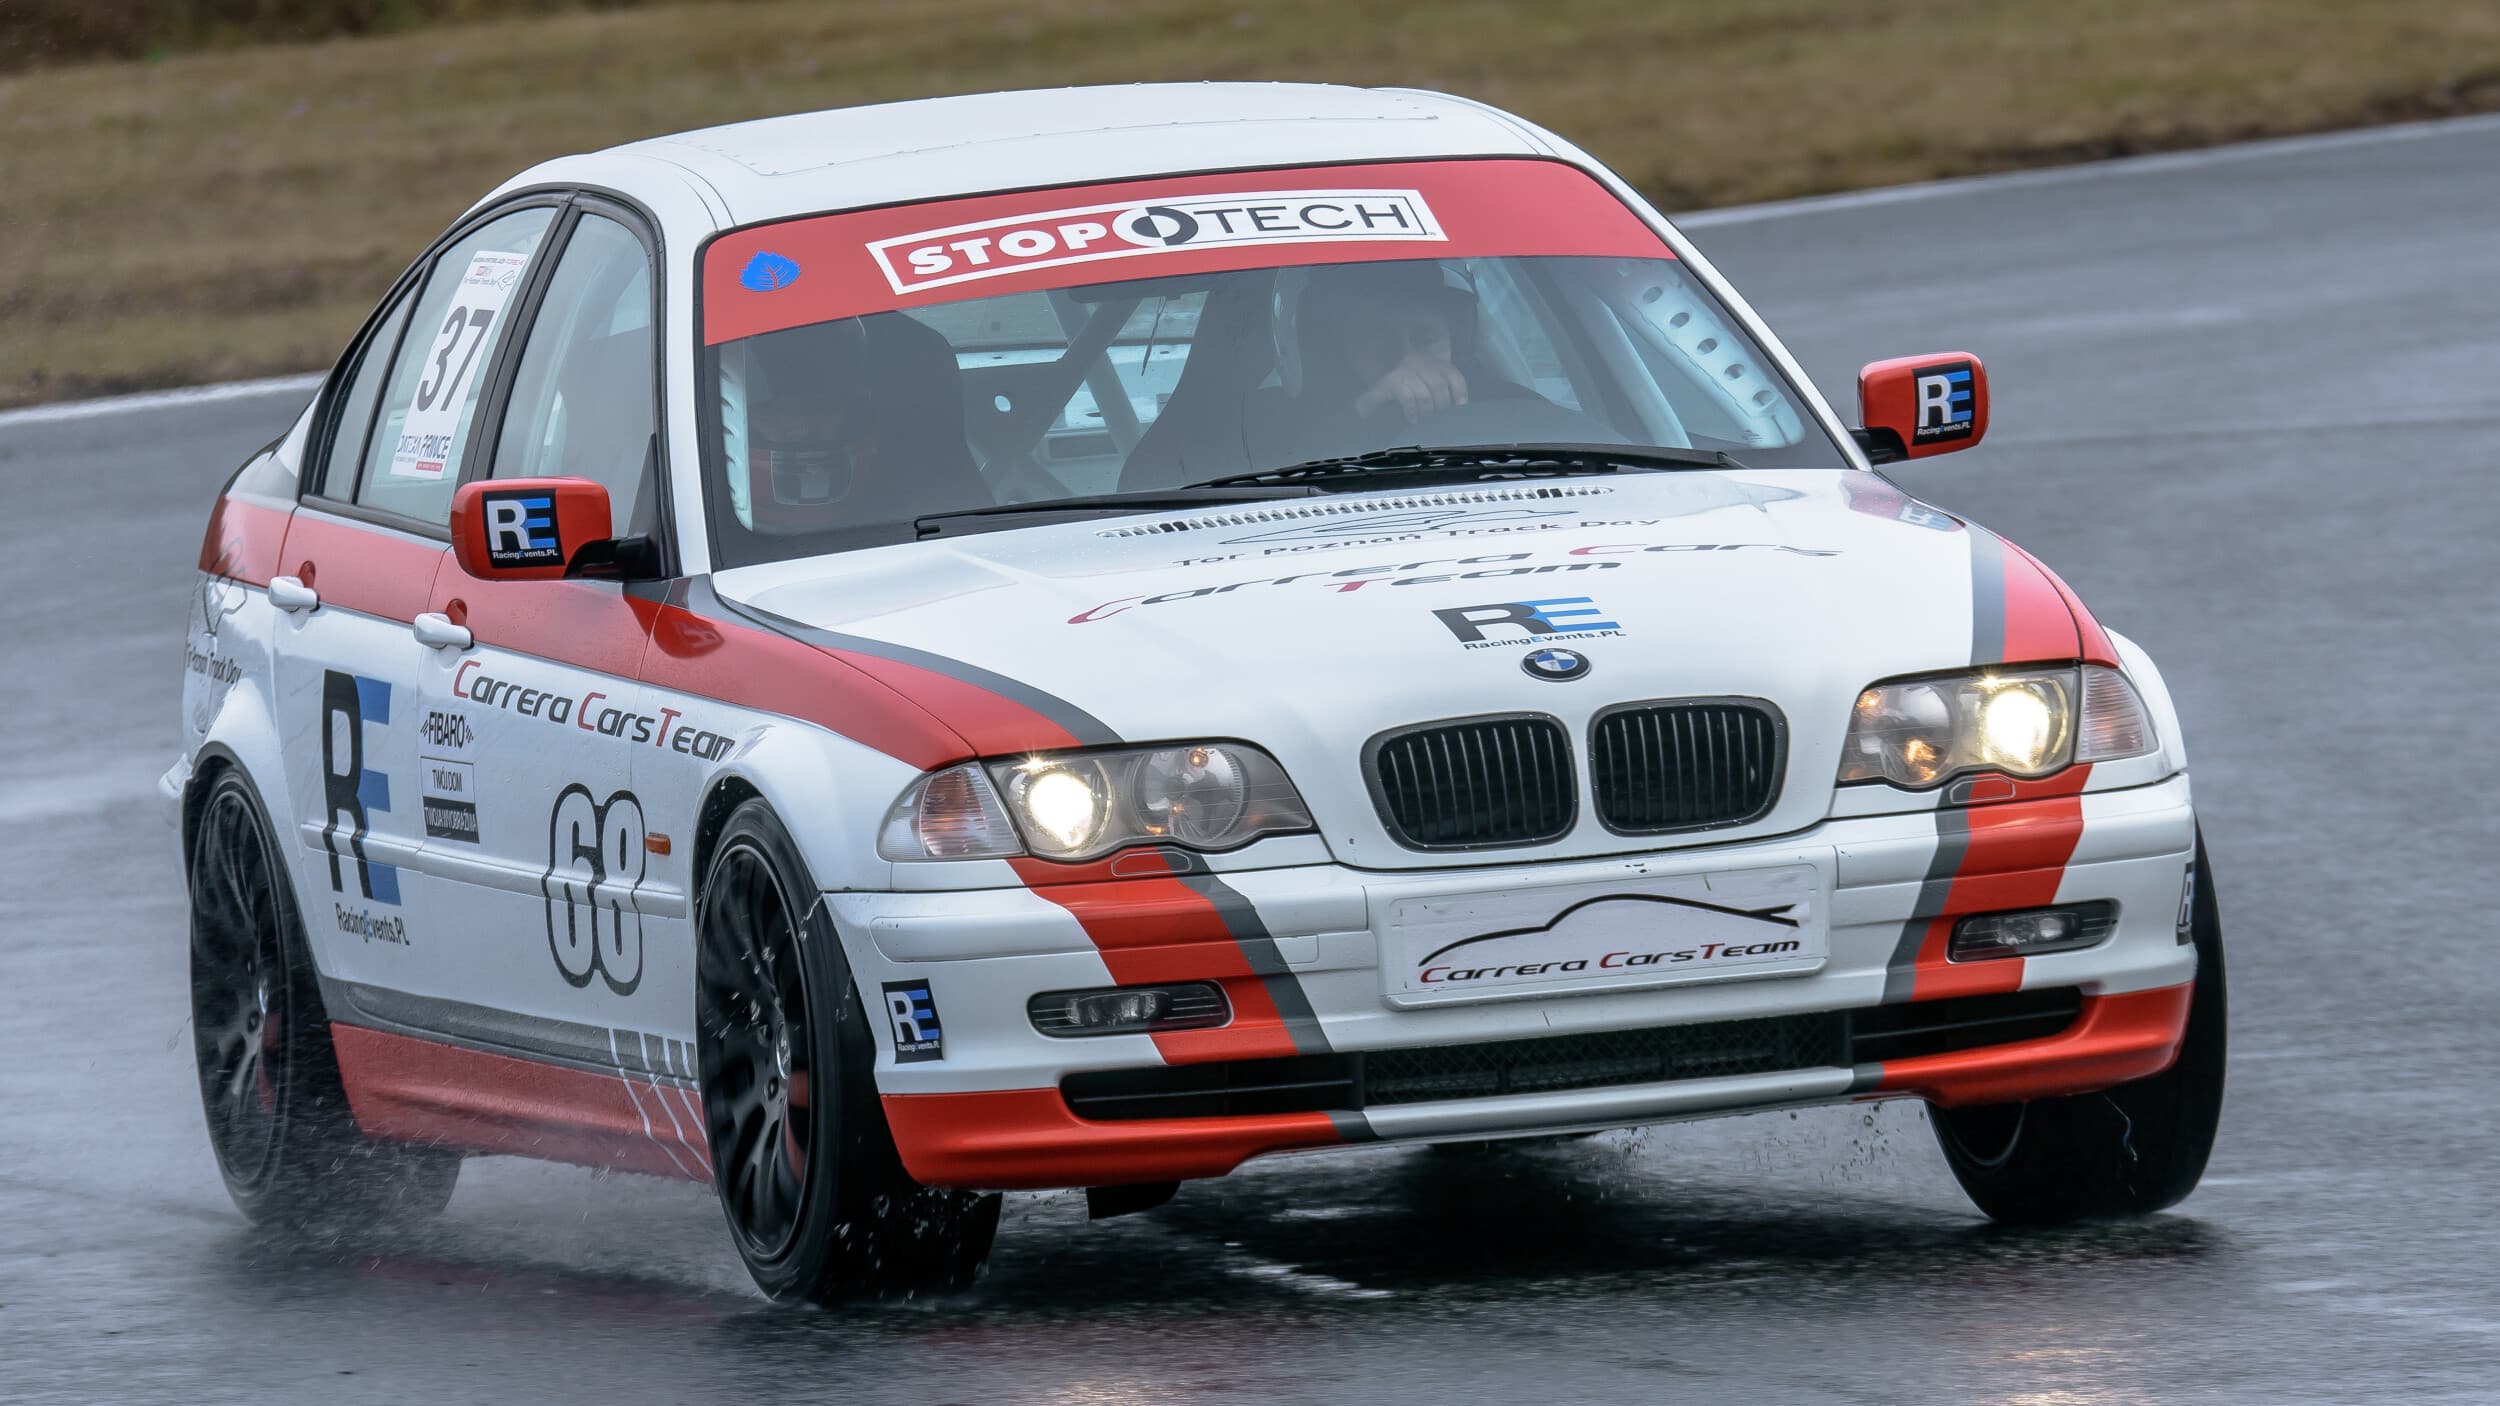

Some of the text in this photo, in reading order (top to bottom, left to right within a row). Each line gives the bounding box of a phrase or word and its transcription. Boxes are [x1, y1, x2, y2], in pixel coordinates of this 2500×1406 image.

[417, 305, 496, 412] 37
[1918, 370, 1972, 428] RE
[486, 497, 557, 551] RE
[1172, 519, 1660, 566] Tor Poznań Track Day
[492, 548, 559, 560] RacingEvents.PL
[1323, 562, 1623, 593] Team
[1067, 543, 1844, 625] Carrera Cars
[1431, 597, 1622, 643] RE
[1463, 630, 1627, 650] RacingEvents.PL
[453, 660, 574, 724] Carrera
[428, 711, 466, 749] FIBARO
[322, 668, 402, 907] RE
[541, 782, 646, 996] 68
[335, 902, 411, 946] RacingEvents.PL
[1420, 959, 1589, 984] Carrera
[885, 989, 940, 1043] RE
